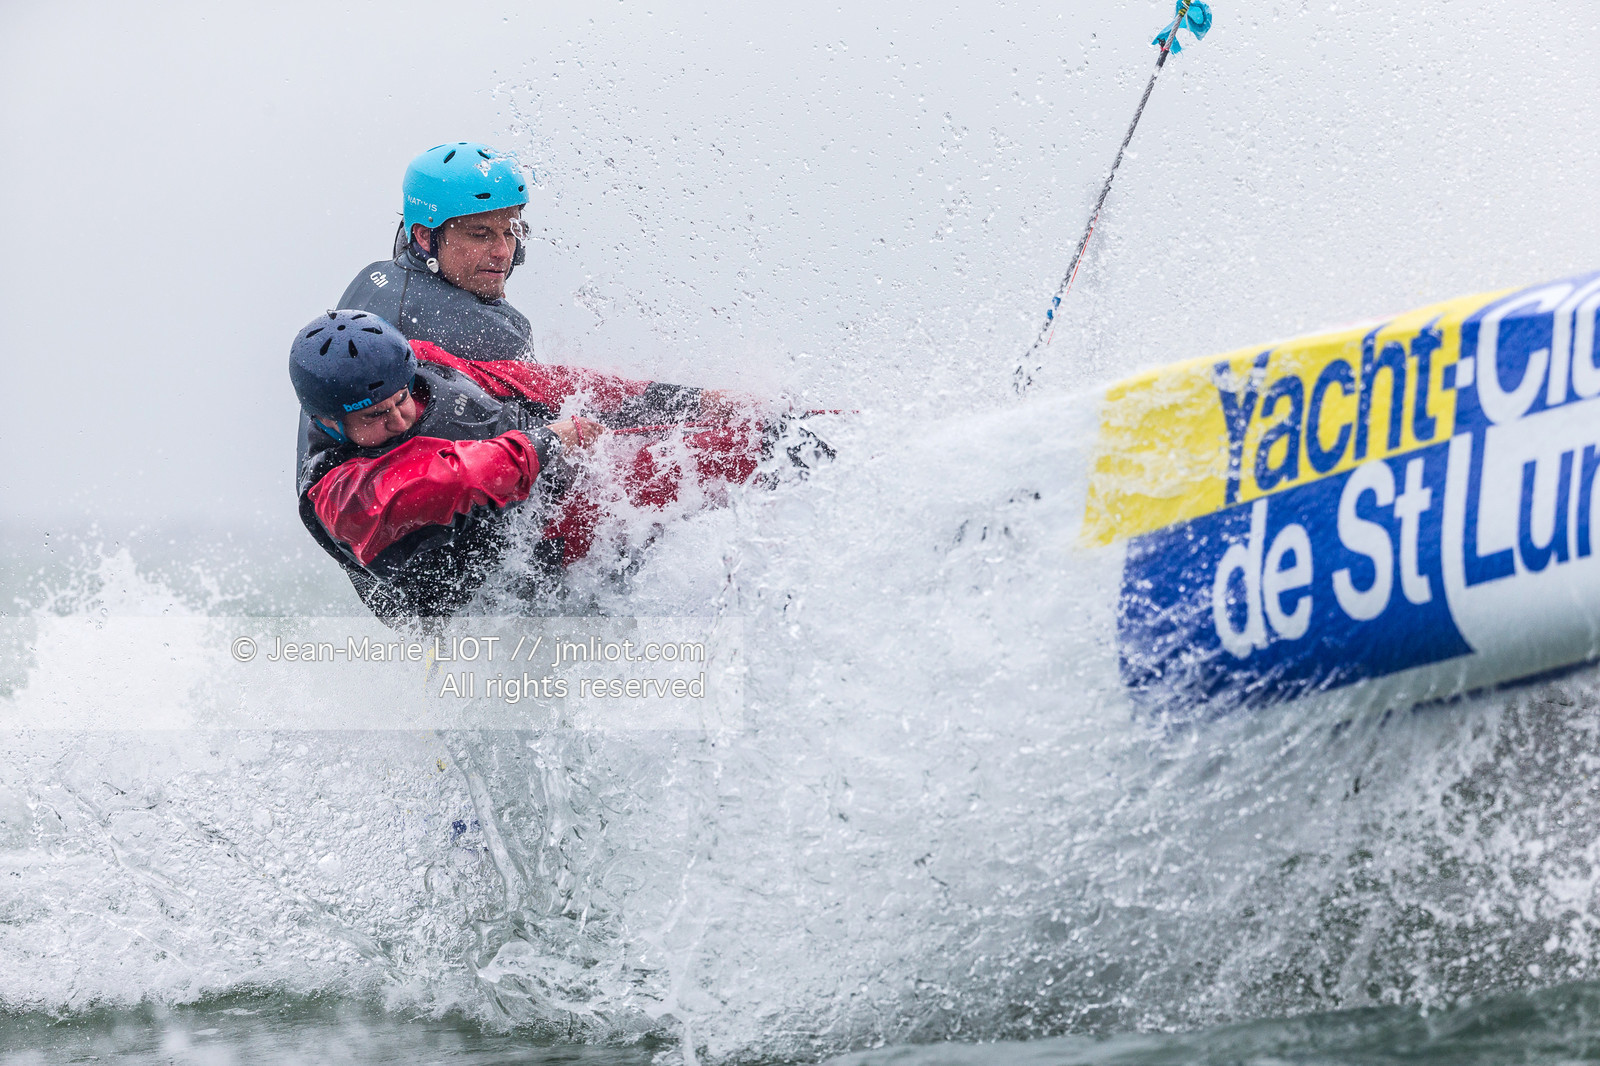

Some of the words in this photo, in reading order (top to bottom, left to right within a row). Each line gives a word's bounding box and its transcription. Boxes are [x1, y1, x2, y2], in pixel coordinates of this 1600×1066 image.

[370, 271, 389, 288] Gill
[343, 398, 373, 412] bern
[454, 393, 470, 416] Gill
[1212, 499, 1313, 658] de
[1332, 457, 1433, 621] St
